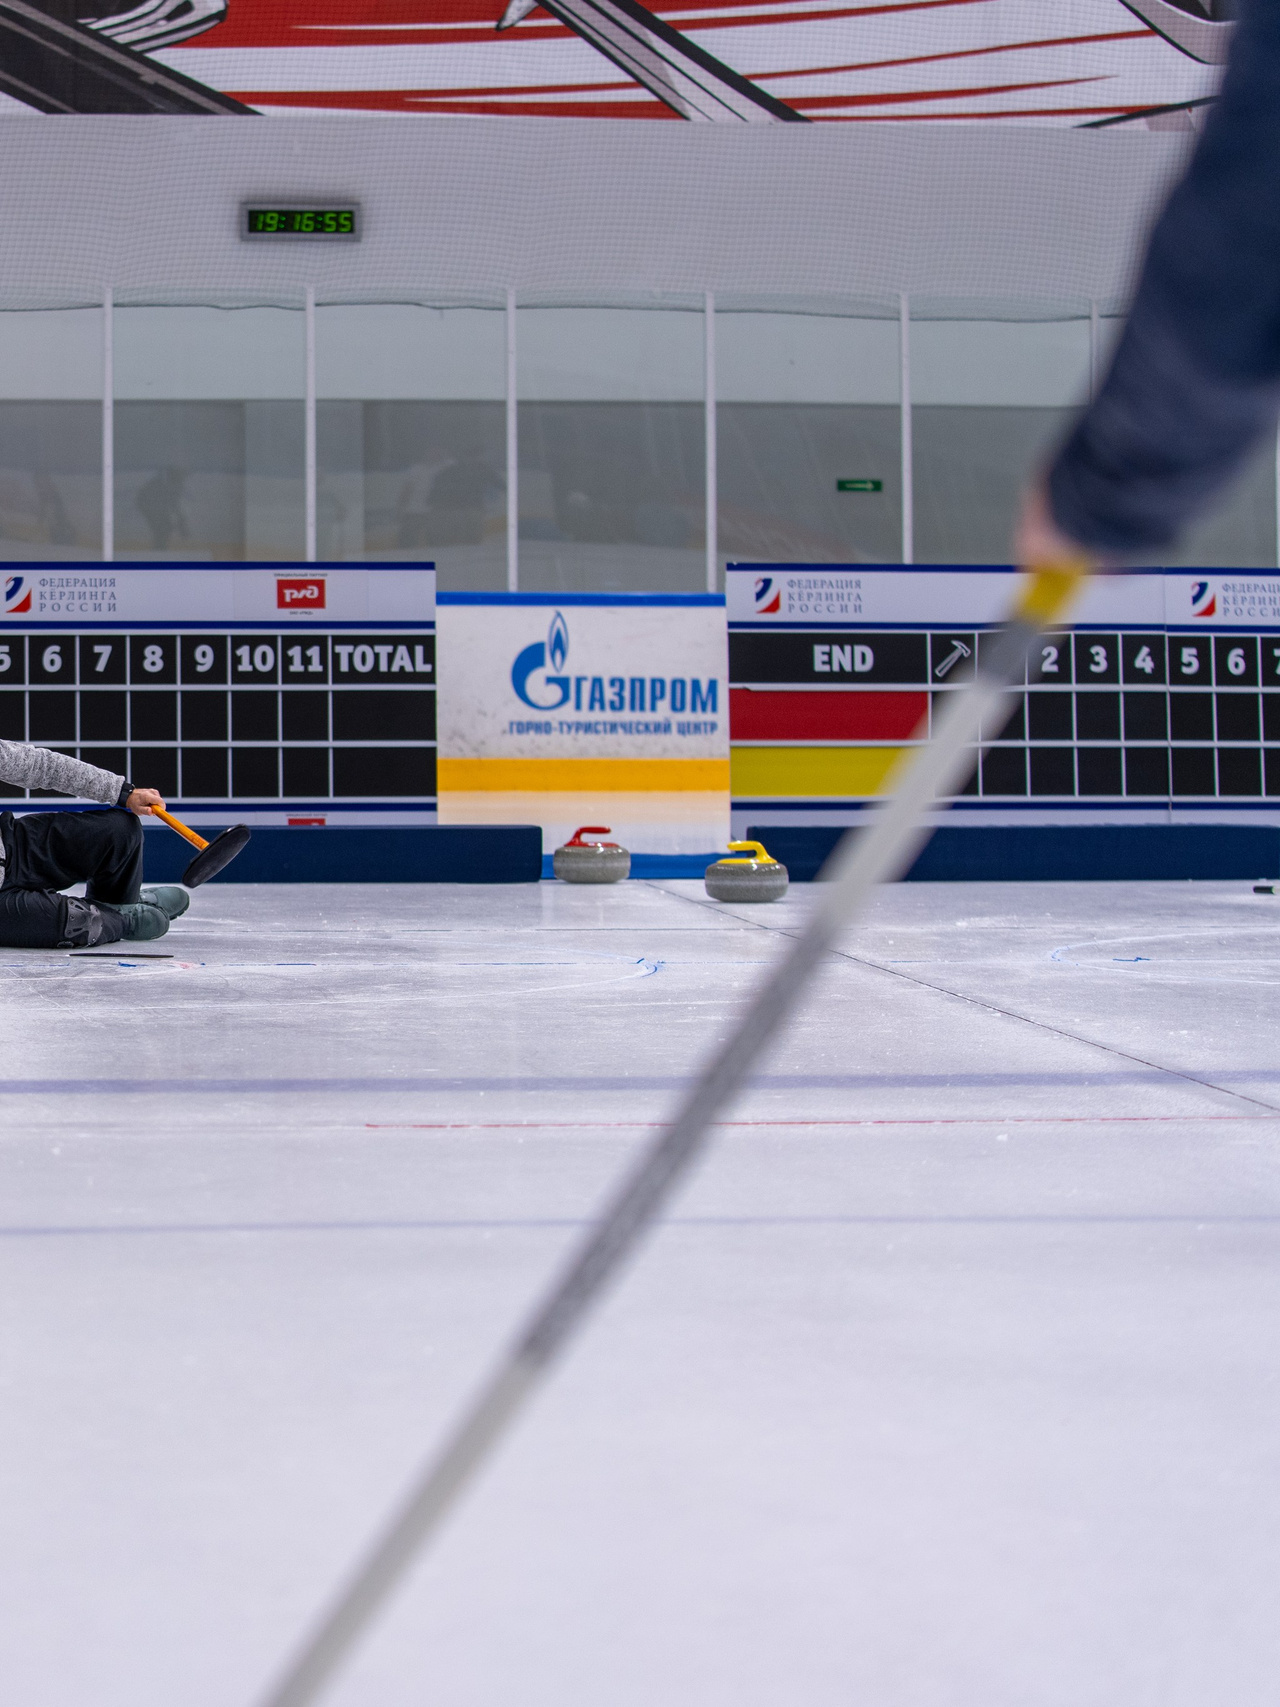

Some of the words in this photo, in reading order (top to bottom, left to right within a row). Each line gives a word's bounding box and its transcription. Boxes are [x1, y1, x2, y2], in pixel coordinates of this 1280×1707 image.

[256, 212, 352, 232] 19:16:55
[39, 578, 116, 588] ФЕДЕРАЦИЯ
[787, 579, 862, 589] ФЕДЕРАЦИЯ
[1222, 583, 1280, 593] ФЕДЕРАЦ
[39, 589, 116, 601] КЁРЛИНГА
[1222, 592, 1280, 606] КЁРЛИН
[39, 602, 116, 612] РОССИИ
[787, 603, 862, 614] РОССИИ
[1222, 607, 1280, 617] РОССИ
[42, 645, 62, 673] 6
[93, 645, 113, 672] 7
[143, 644, 164, 673] 8
[194, 644, 214, 673] 9
[235, 644, 275, 673] 10
[287, 645, 324, 672] 11
[334, 644, 432, 673] TOTAL
[813, 644, 874, 673] END
[1040, 645, 1059, 673] 2
[1089, 645, 1108, 673] 3
[1134, 645, 1155, 674] 4
[1180, 647, 1200, 675] 5
[1227, 647, 1246, 676] 6
[574, 676, 719, 713] ГАЗПРОМ
[509, 718, 672, 736] ГОРНО-ТУРИСТИЧЕСКИЙ
[677, 720, 719, 737] ЦЕНТР
